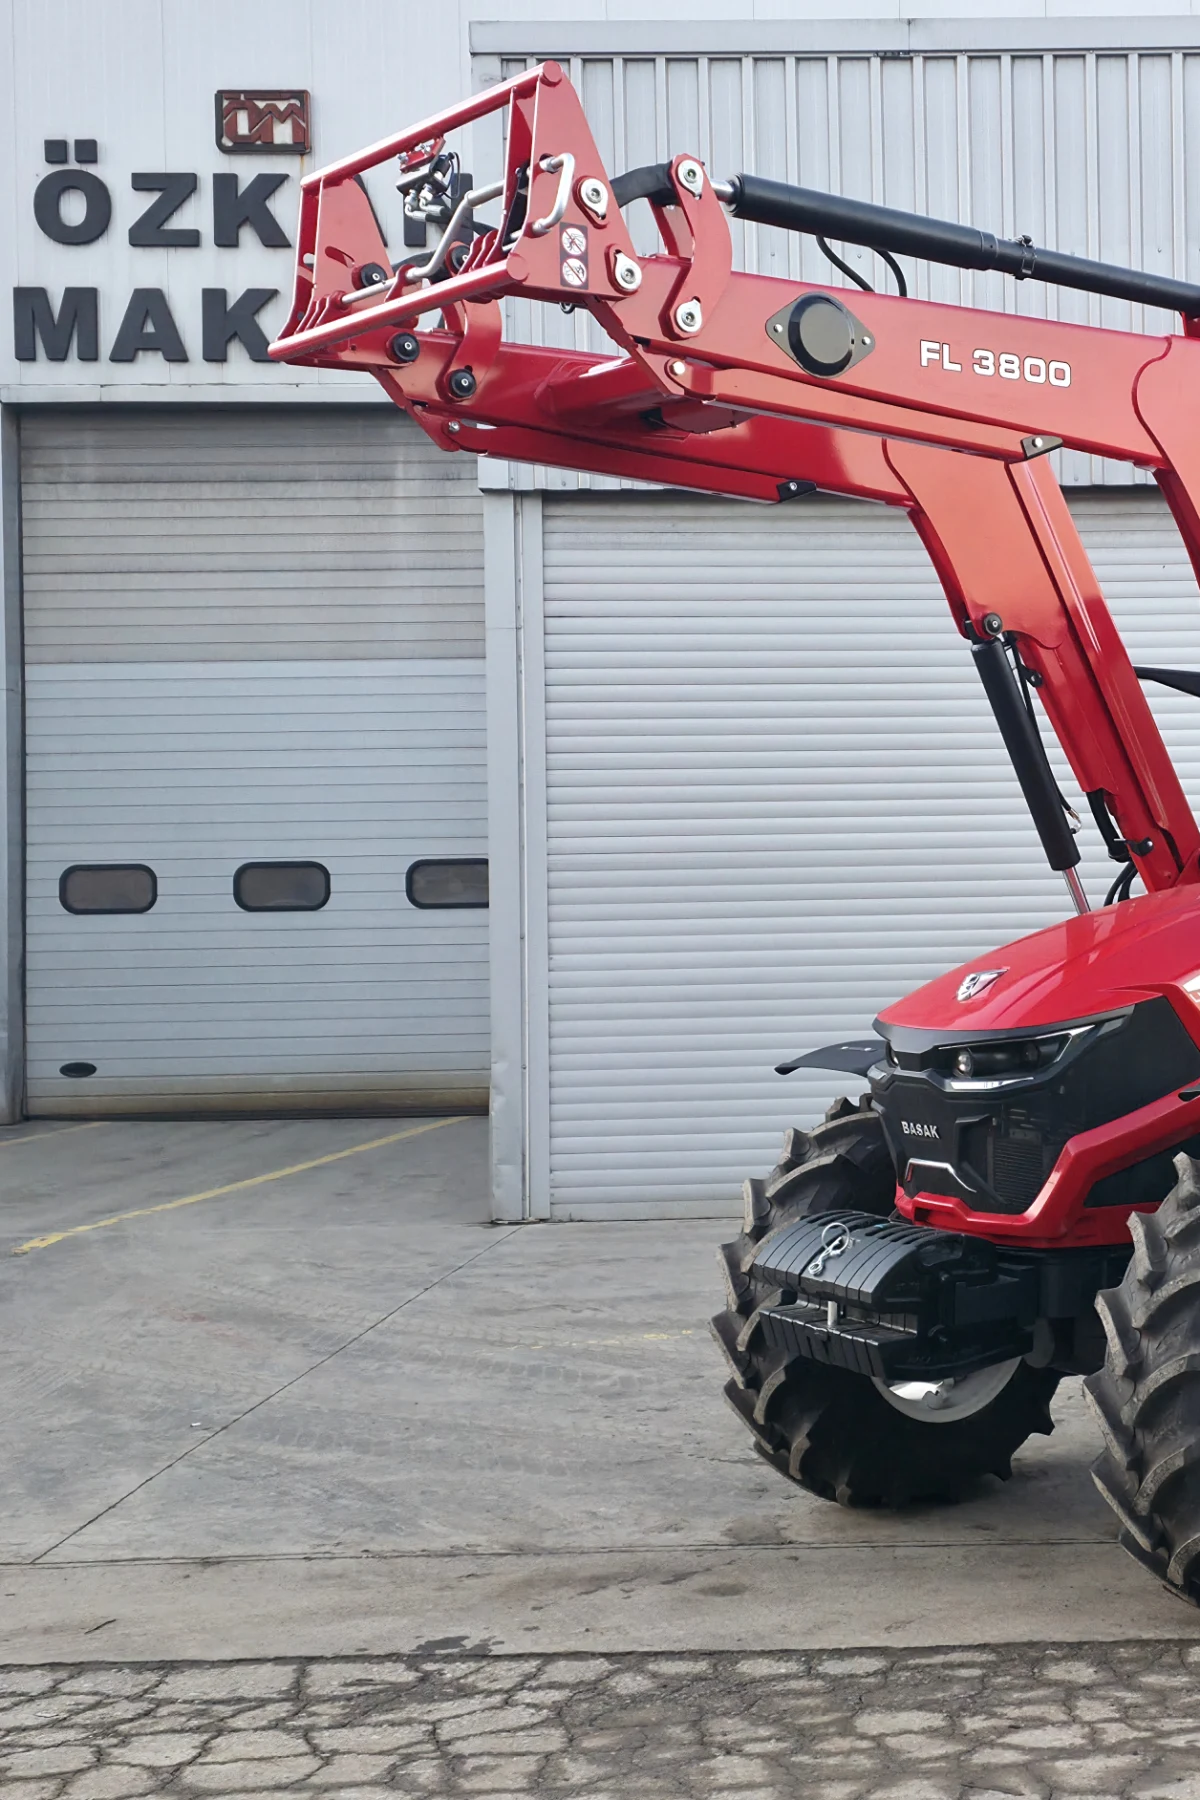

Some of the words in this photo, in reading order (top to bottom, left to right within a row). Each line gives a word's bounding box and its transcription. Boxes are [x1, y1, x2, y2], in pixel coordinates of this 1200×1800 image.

[34, 139, 473, 248] ÖZKN
[920, 339, 963, 373] FL
[972, 348, 1072, 389] 3800
[901, 1120, 940, 1139] BASAK
